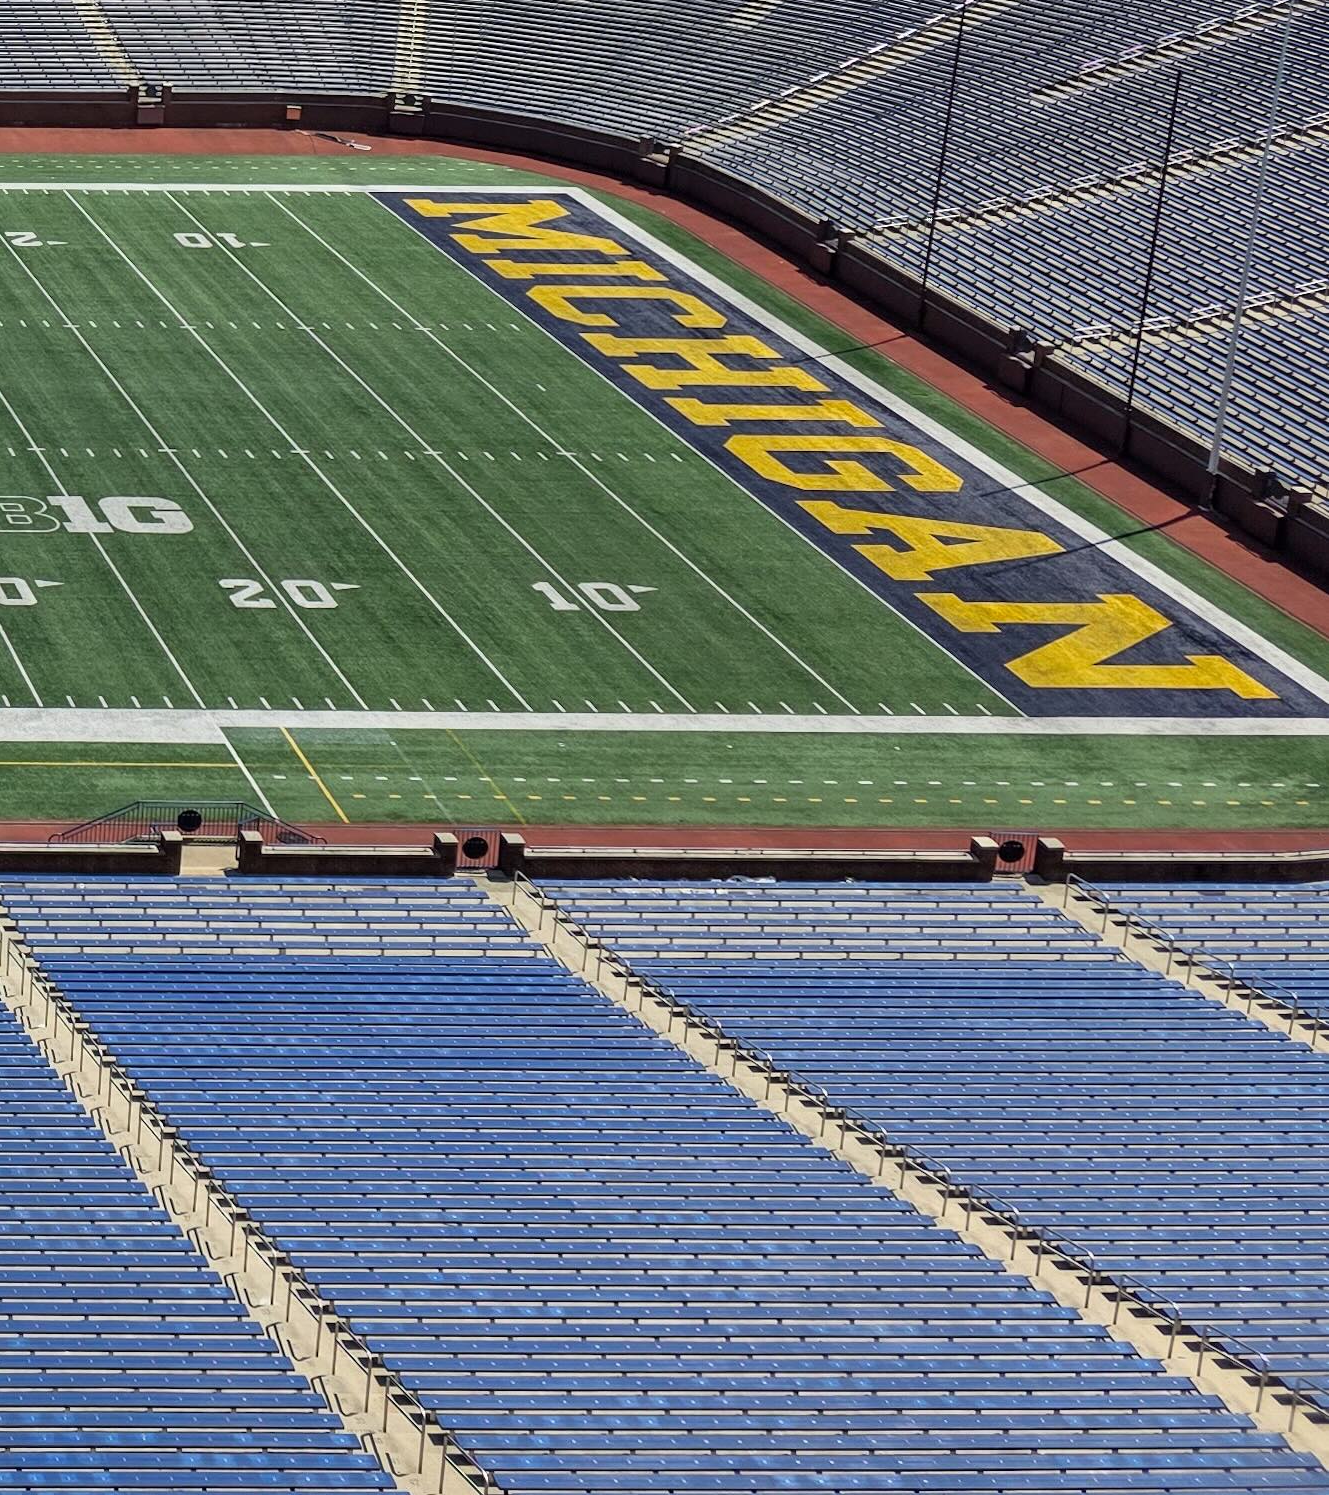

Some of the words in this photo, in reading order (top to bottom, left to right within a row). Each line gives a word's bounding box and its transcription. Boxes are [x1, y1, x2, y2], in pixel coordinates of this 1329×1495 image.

[172, 232, 247, 248] 10
[402, 198, 1282, 700] MICHIGAN
[218, 578, 339, 609] 20
[531, 581, 642, 611] 10
